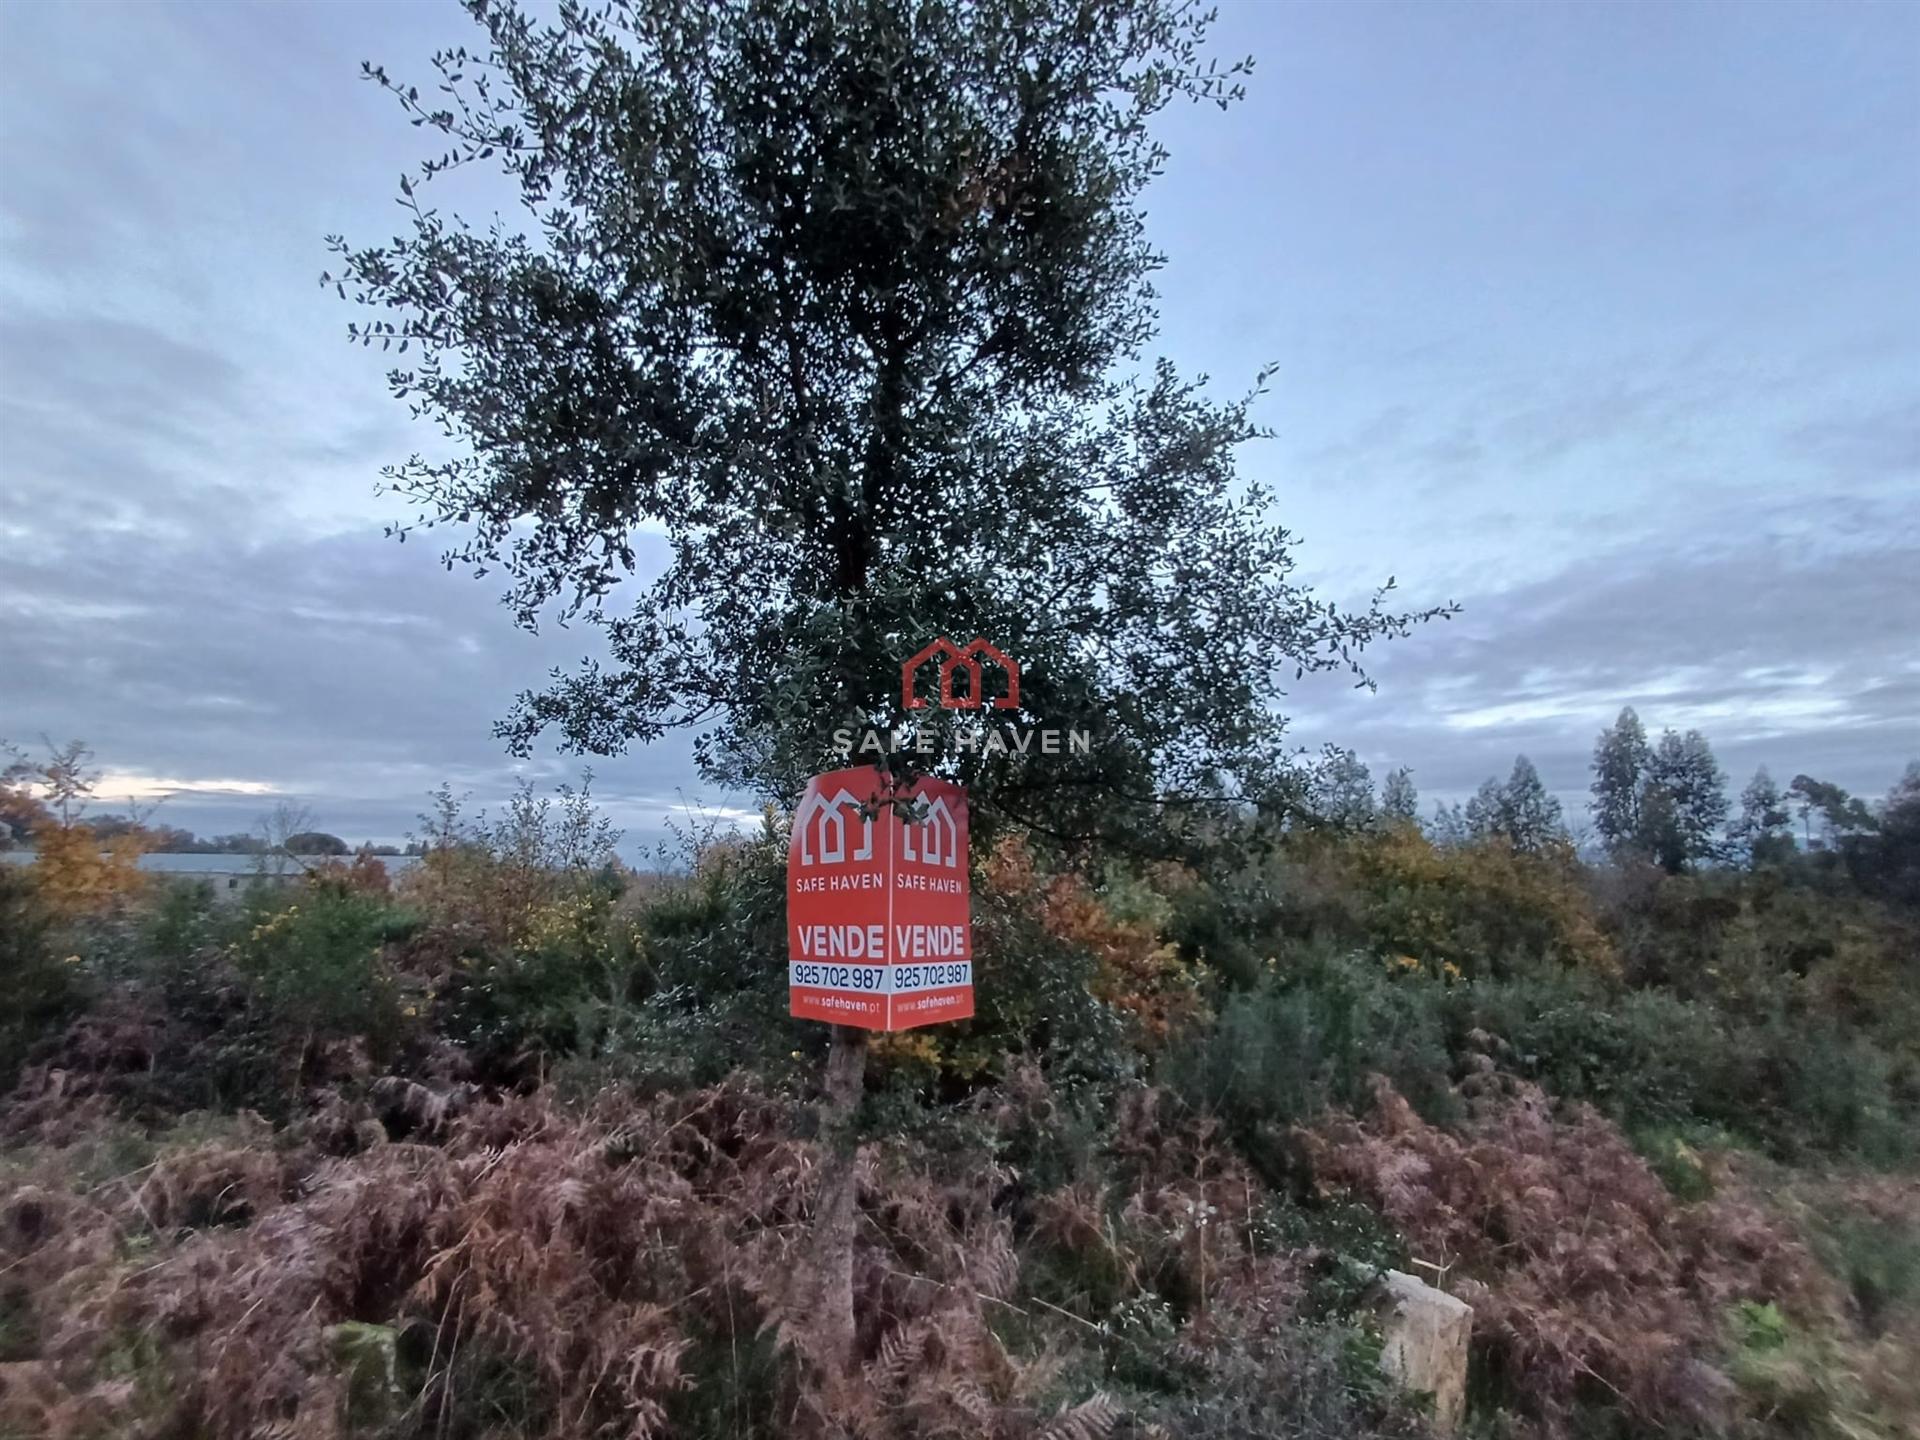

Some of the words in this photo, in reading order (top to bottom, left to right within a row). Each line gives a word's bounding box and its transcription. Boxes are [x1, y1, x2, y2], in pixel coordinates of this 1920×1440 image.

[796, 876, 825, 892] SAFE
[830, 873, 883, 890] HAVEN
[897, 873, 926, 891] SAFE
[929, 877, 962, 894] HAVEN
[797, 924, 885, 959] VENDE
[896, 924, 964, 958] VENDE
[802, 994, 880, 1014] www.safehaven.pt
[896, 993, 964, 1013] www.safehaven.pt
